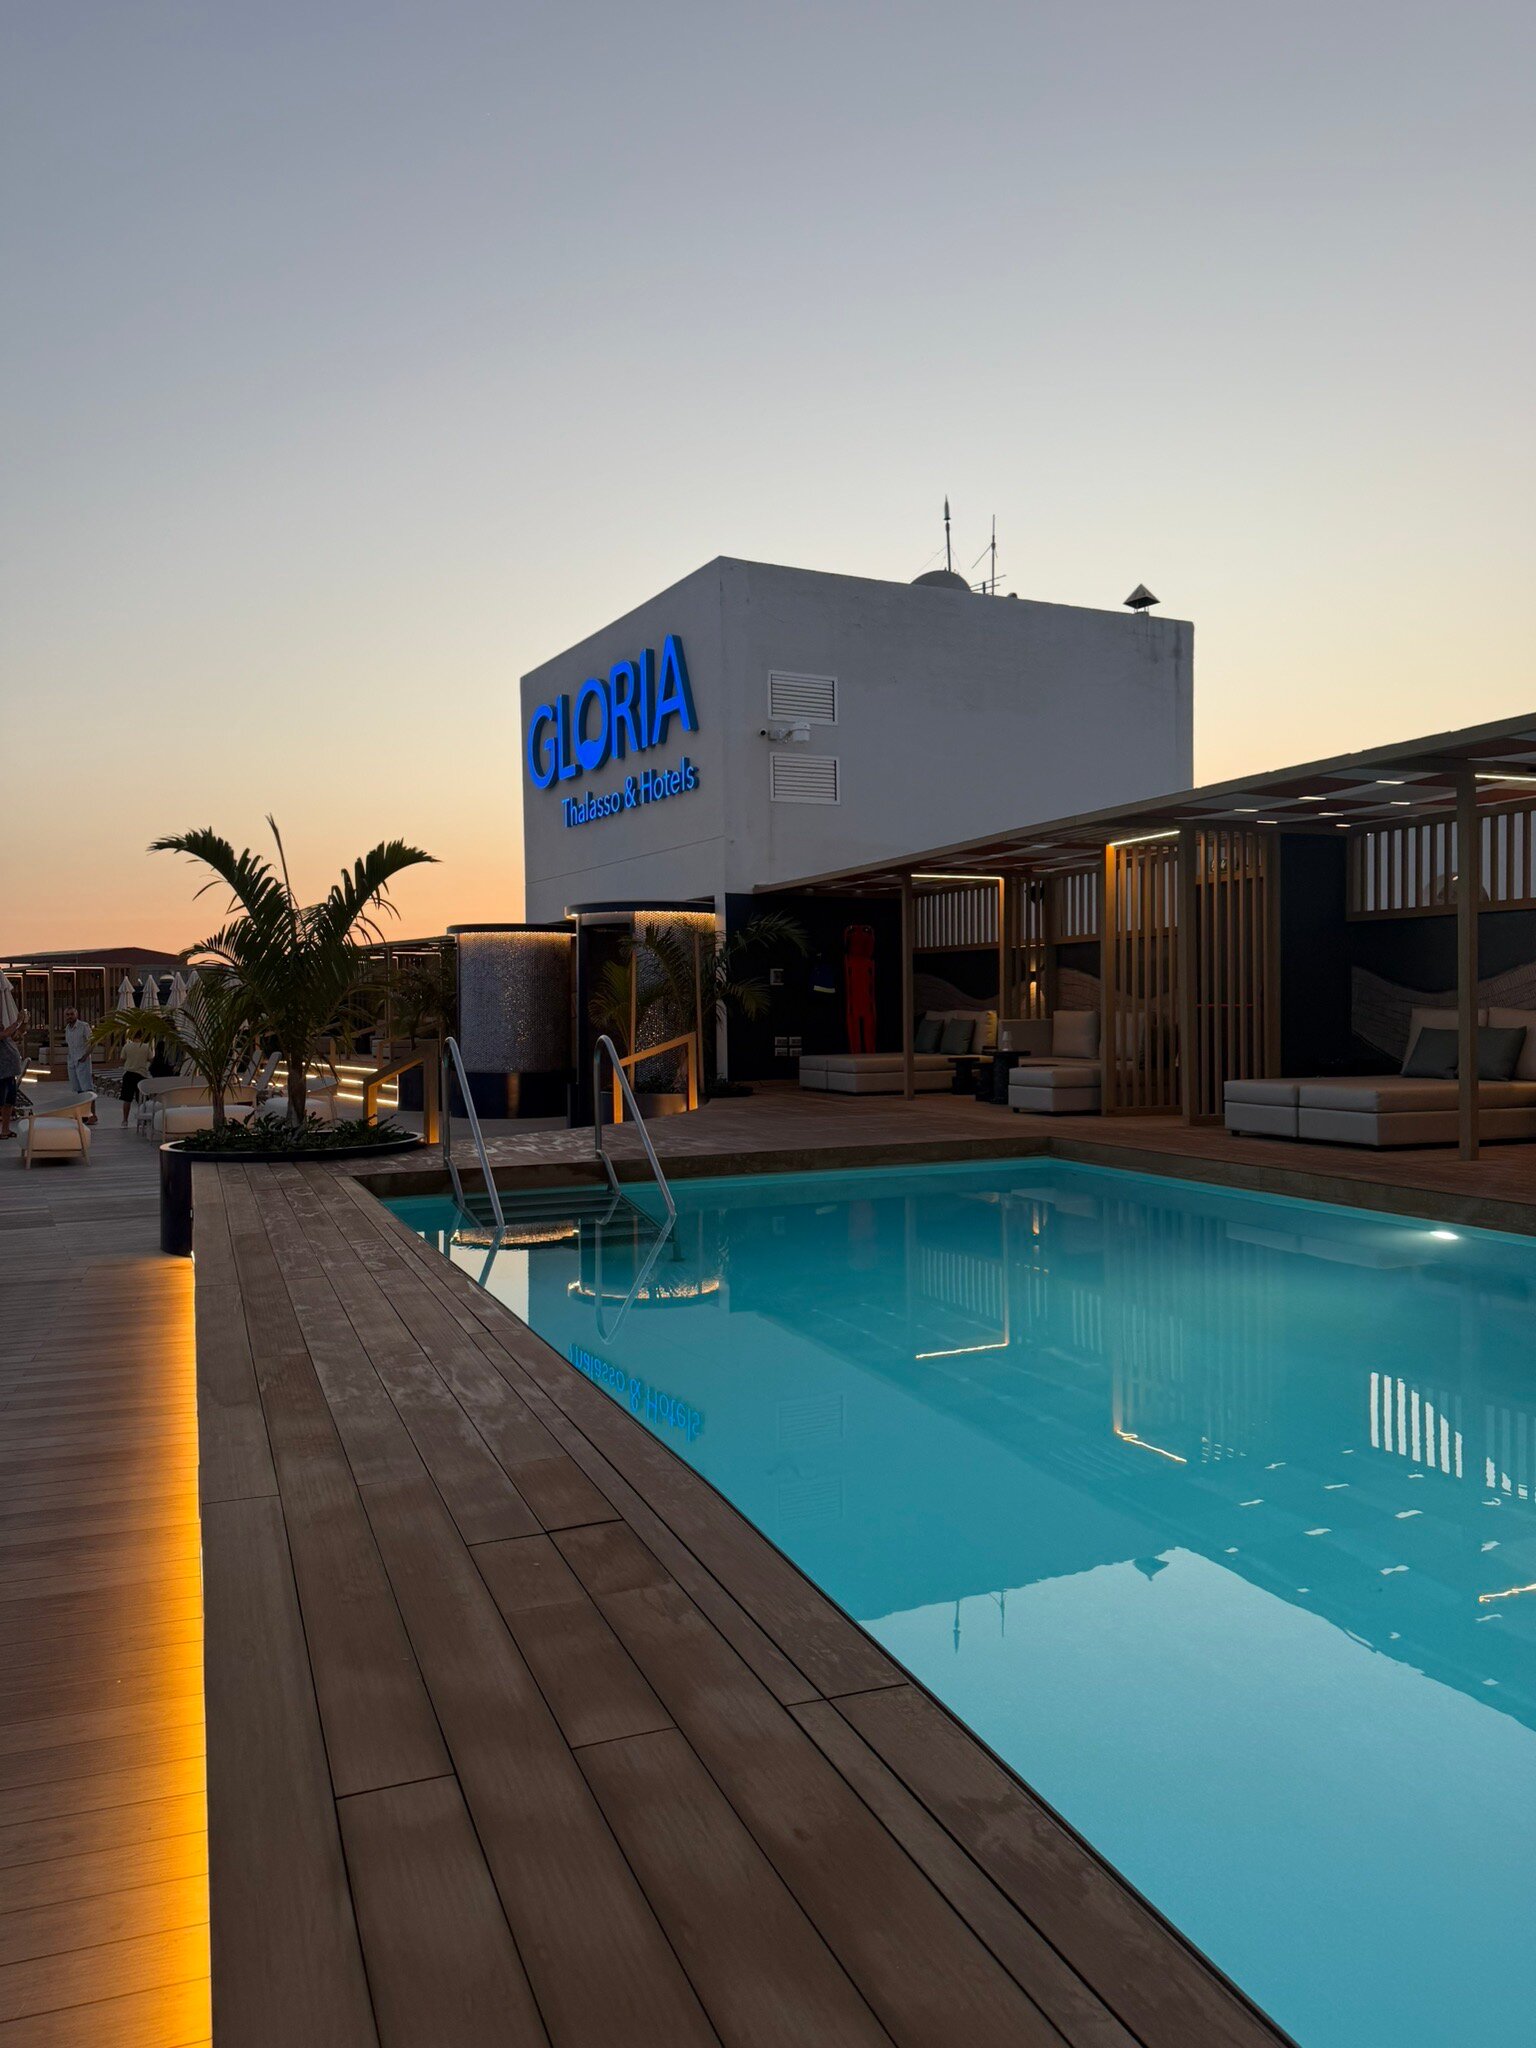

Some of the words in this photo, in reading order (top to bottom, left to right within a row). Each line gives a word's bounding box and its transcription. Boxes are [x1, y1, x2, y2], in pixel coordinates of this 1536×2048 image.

[527, 632, 696, 789] GLORIA
[561, 791, 622, 828] Thalasso
[624, 775, 639, 809] &
[640, 756, 698, 804] Hotels
